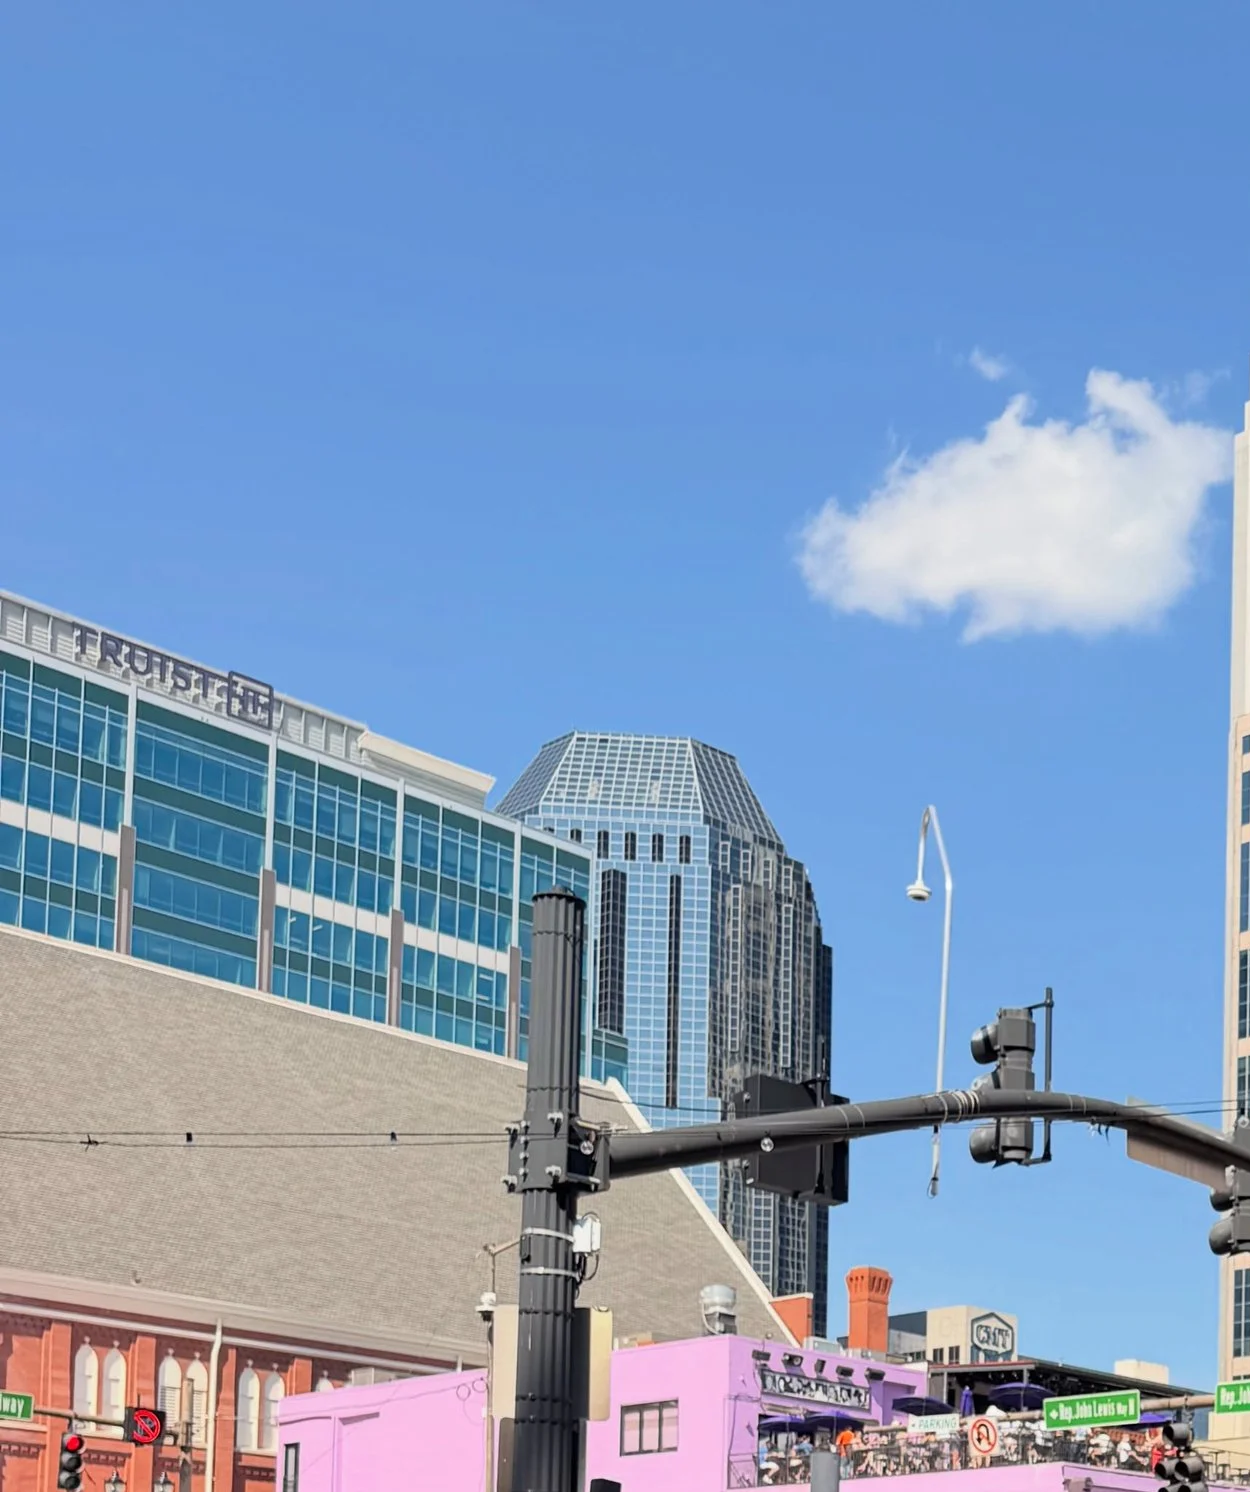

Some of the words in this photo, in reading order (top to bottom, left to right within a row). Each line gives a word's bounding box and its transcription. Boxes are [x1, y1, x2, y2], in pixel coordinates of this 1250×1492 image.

[72, 621, 227, 699] TRUIST
[1075, 1400, 1092, 1419] John
[1093, 1399, 1114, 1417] Lewis
[919, 1418, 957, 1430] PARKING
